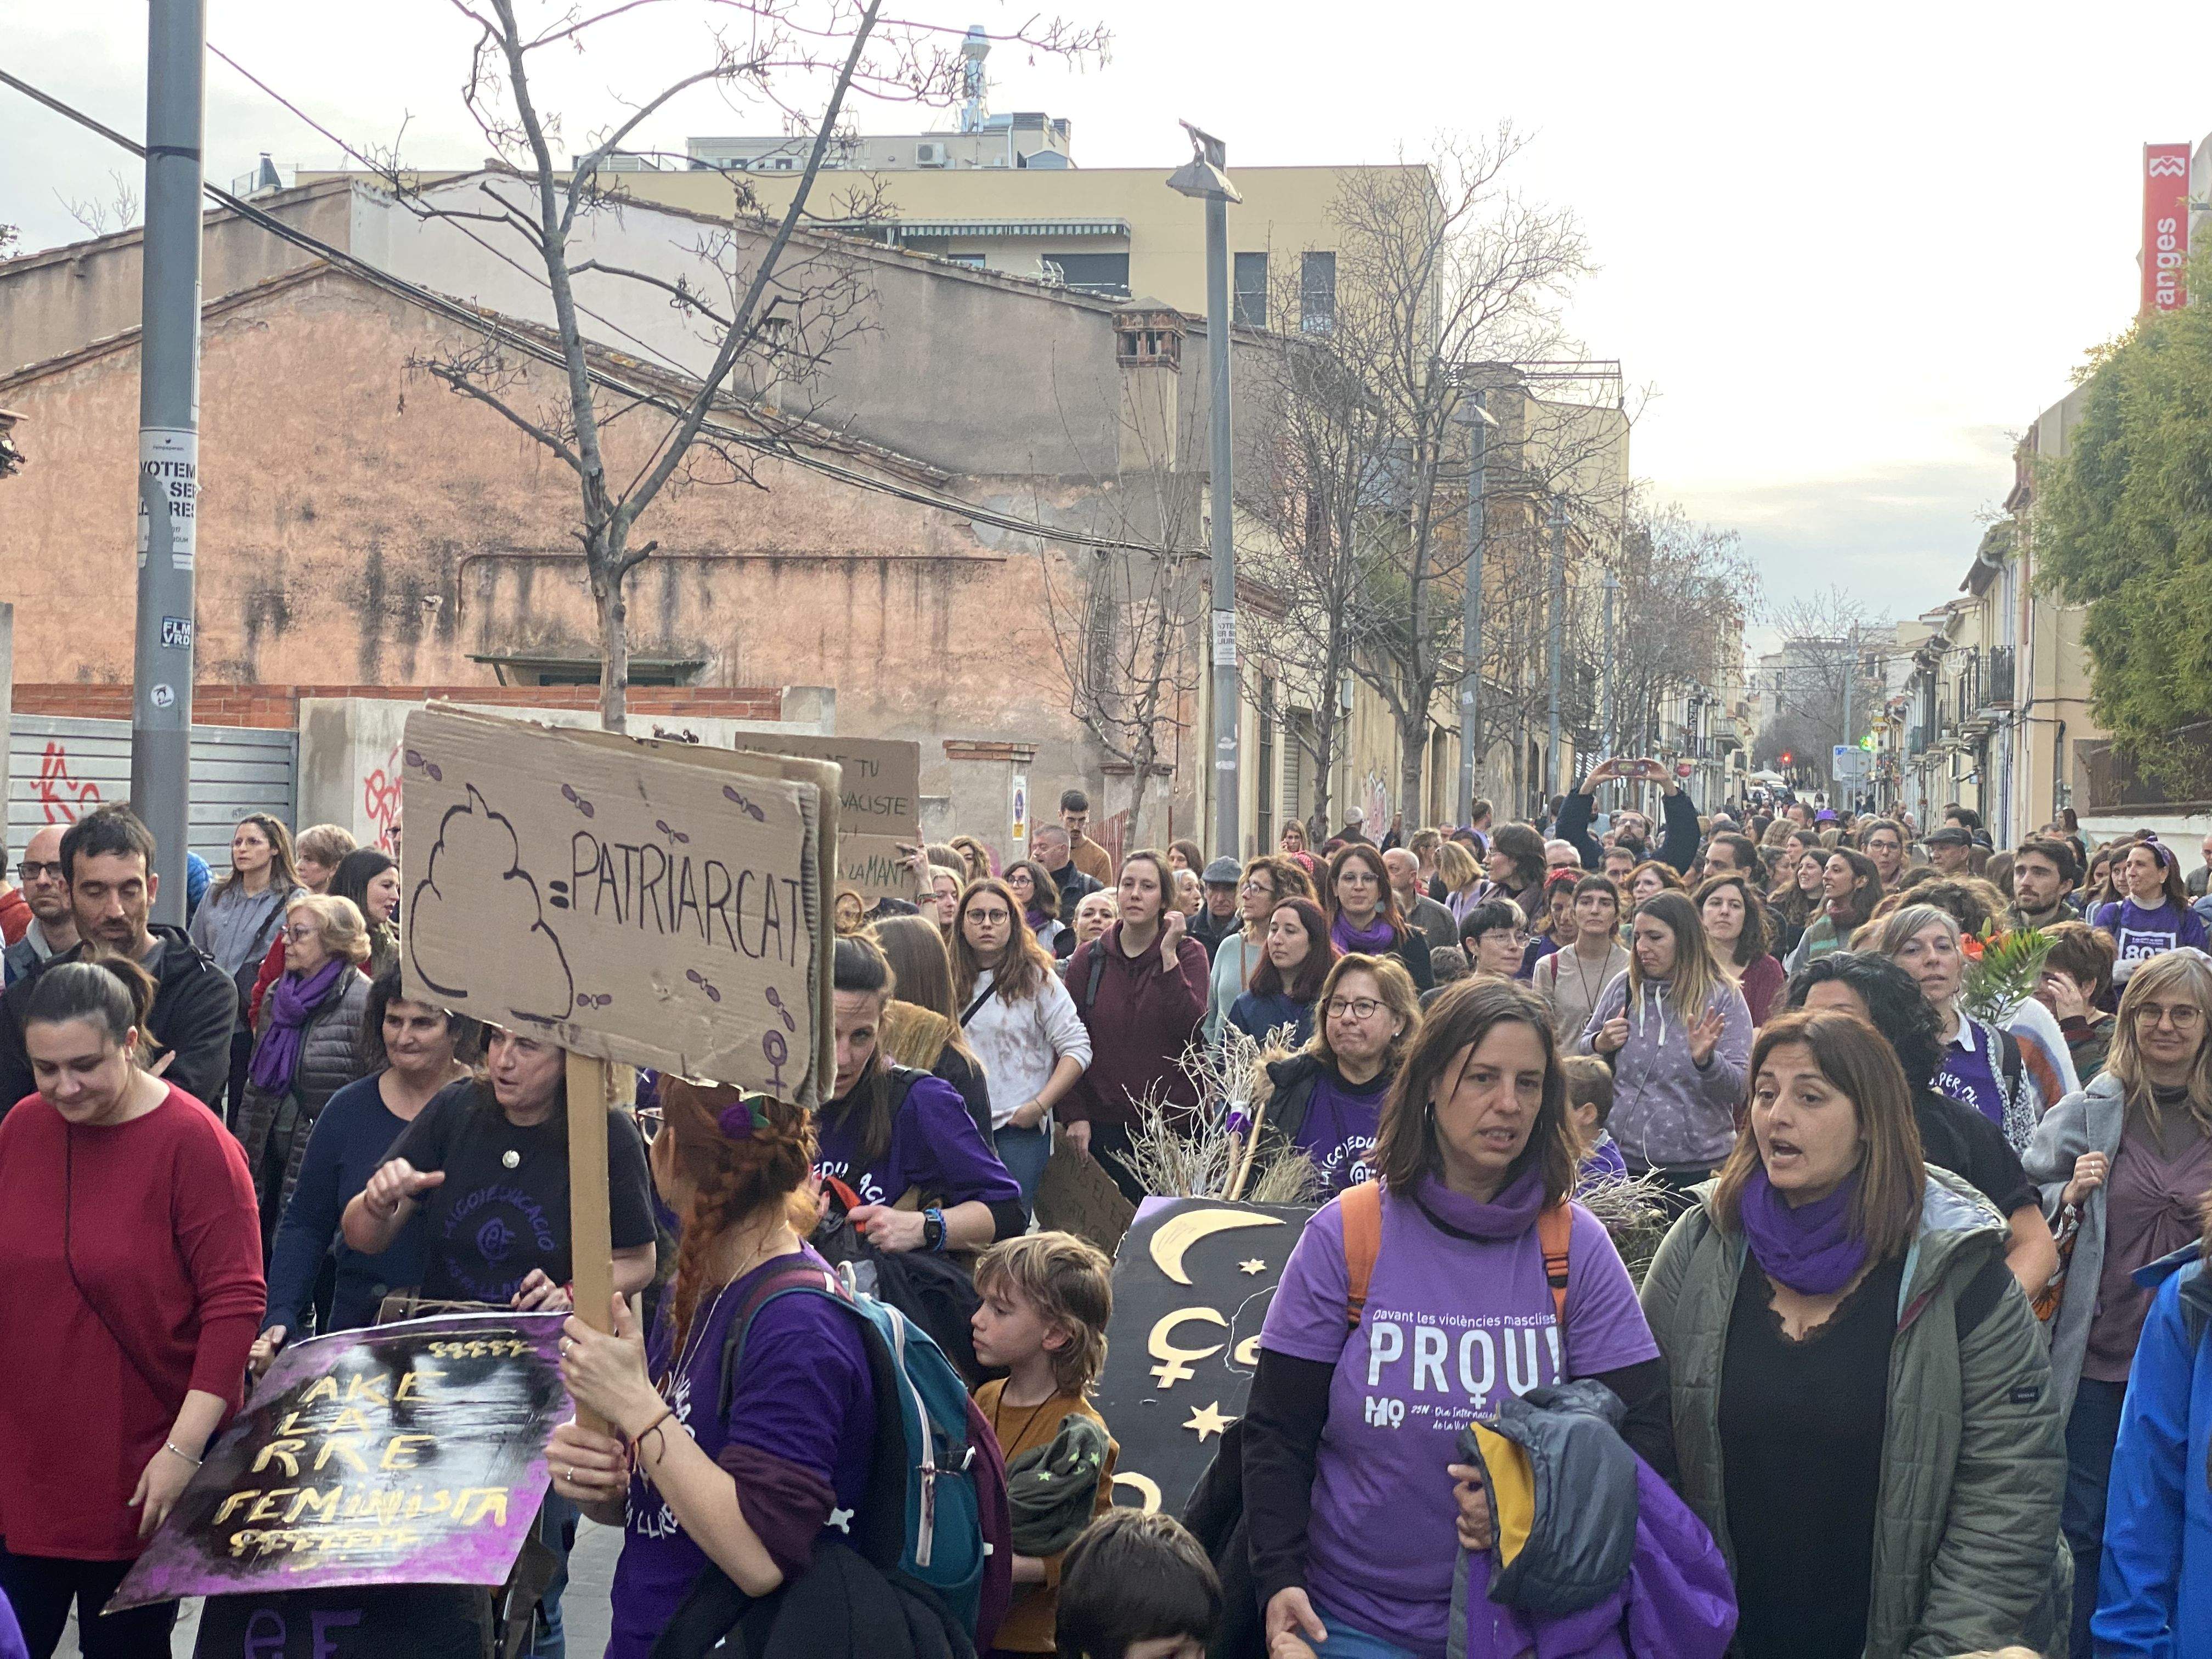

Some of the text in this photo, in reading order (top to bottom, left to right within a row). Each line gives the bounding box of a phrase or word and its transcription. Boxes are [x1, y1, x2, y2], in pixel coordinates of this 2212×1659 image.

[2156, 218, 2182, 308] anges
[854, 759, 879, 778] TU
[572, 830, 800, 968] PATRIARCAT
[1372, 1309, 1414, 1323] Davant
[1417, 1311, 1436, 1325] les
[1438, 1313, 1501, 1328] violències
[1367, 1322, 1561, 1409] PROU!
[299, 1372, 448, 1408] AKE
[277, 1408, 370, 1436] LA
[252, 1434, 437, 1479] RRE
